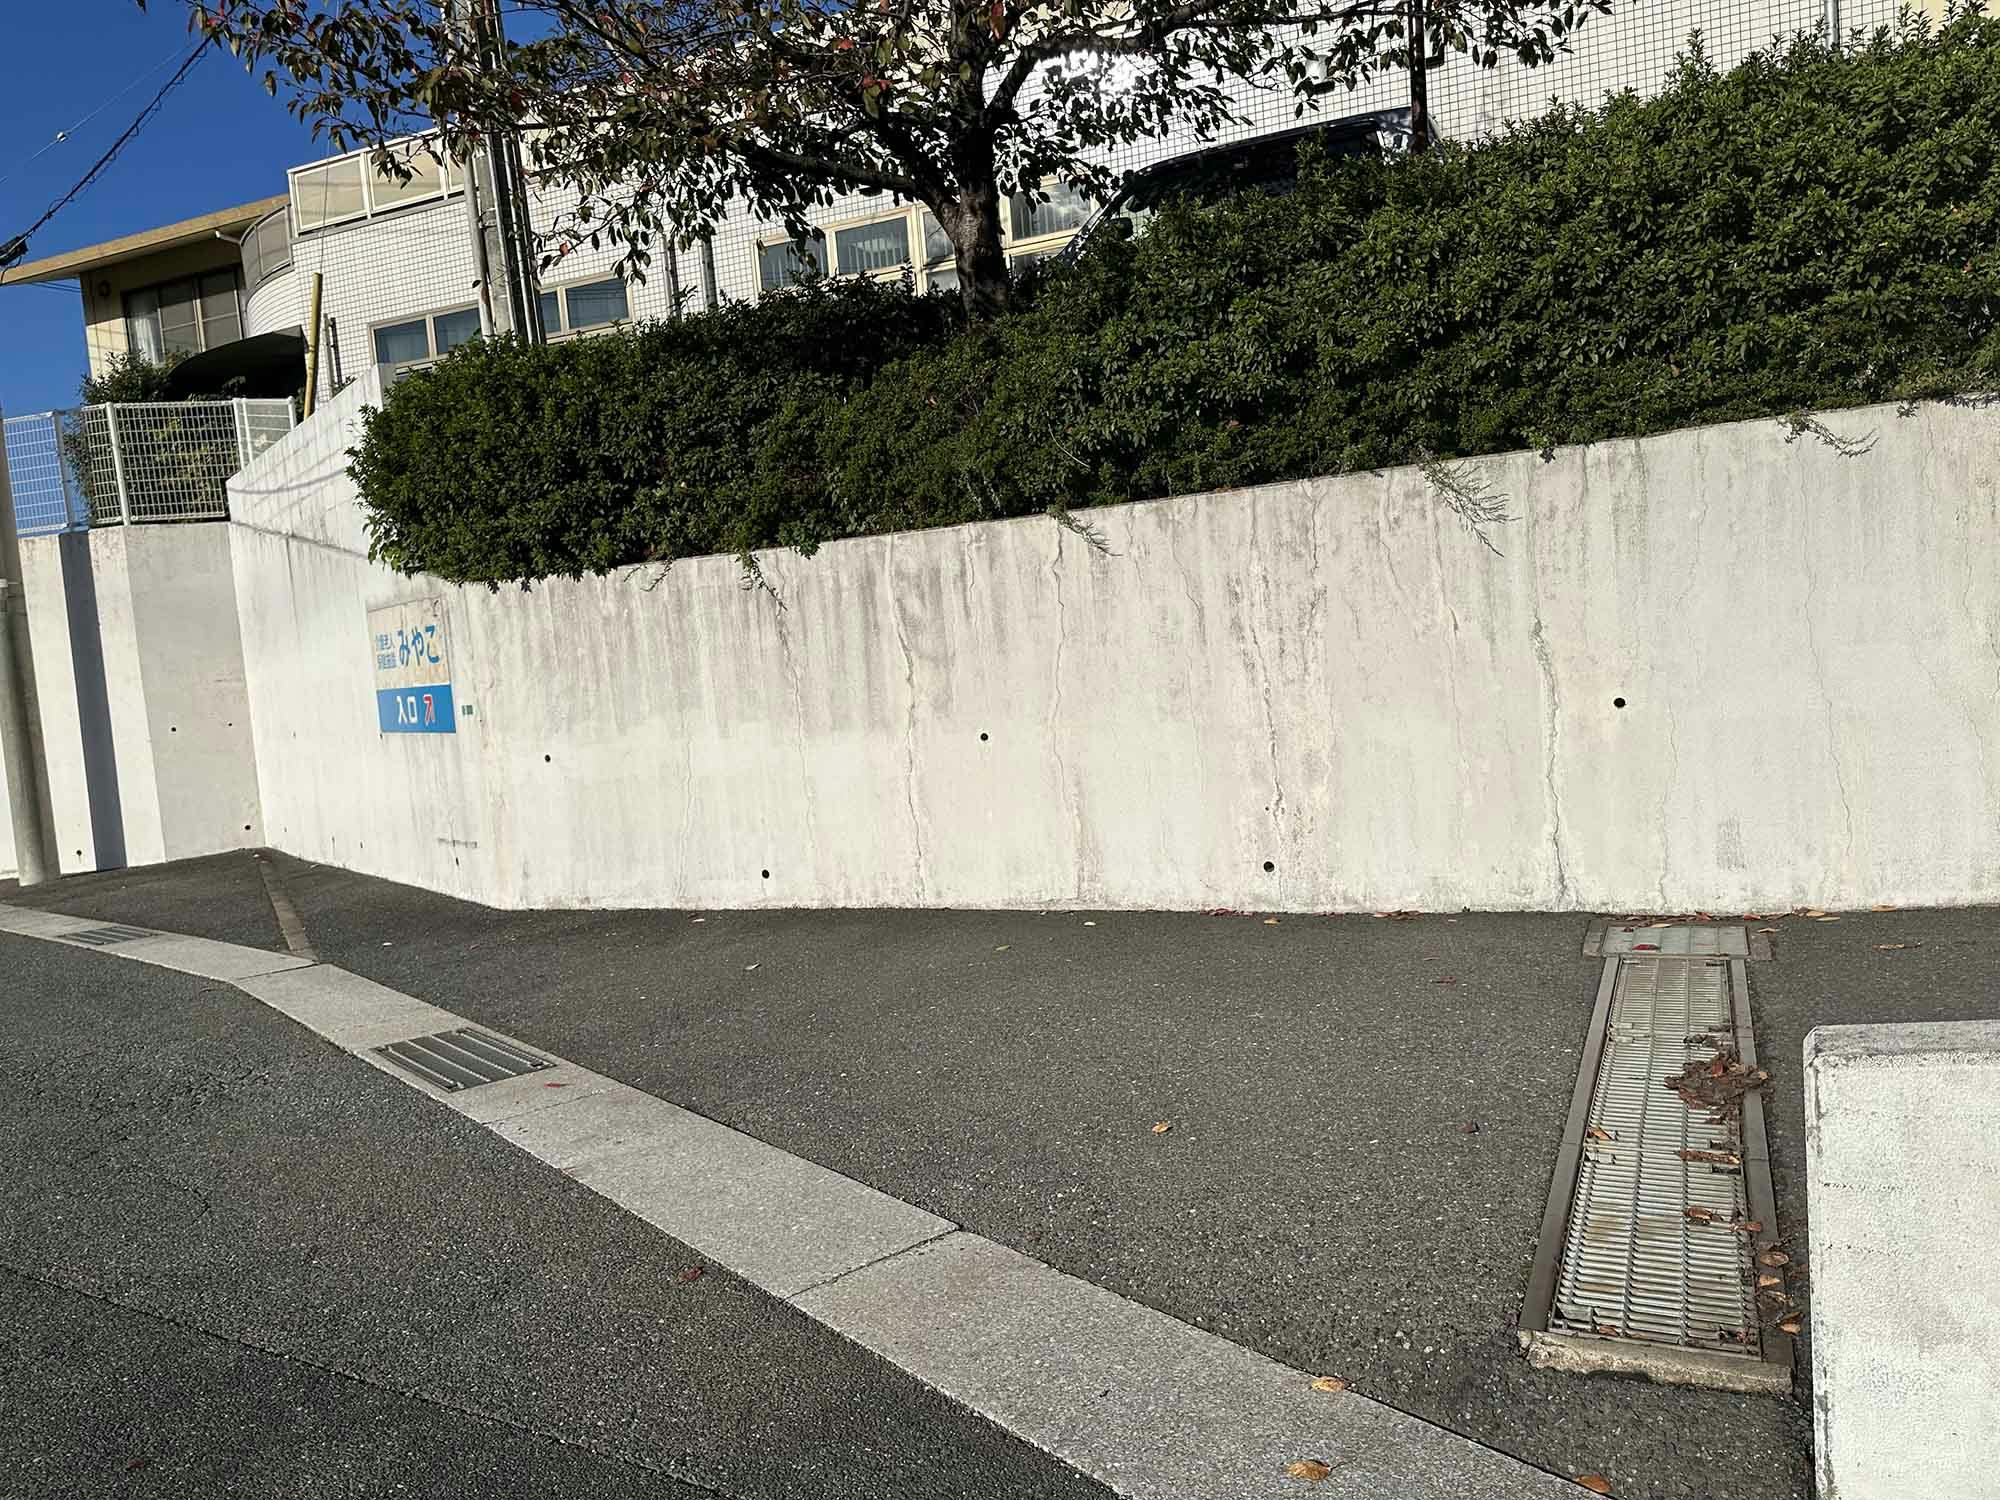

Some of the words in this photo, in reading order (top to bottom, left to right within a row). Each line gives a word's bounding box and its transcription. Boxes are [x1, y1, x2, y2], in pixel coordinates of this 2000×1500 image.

[397, 624, 440, 667] みやこ
[396, 695, 418, 725] 入口
